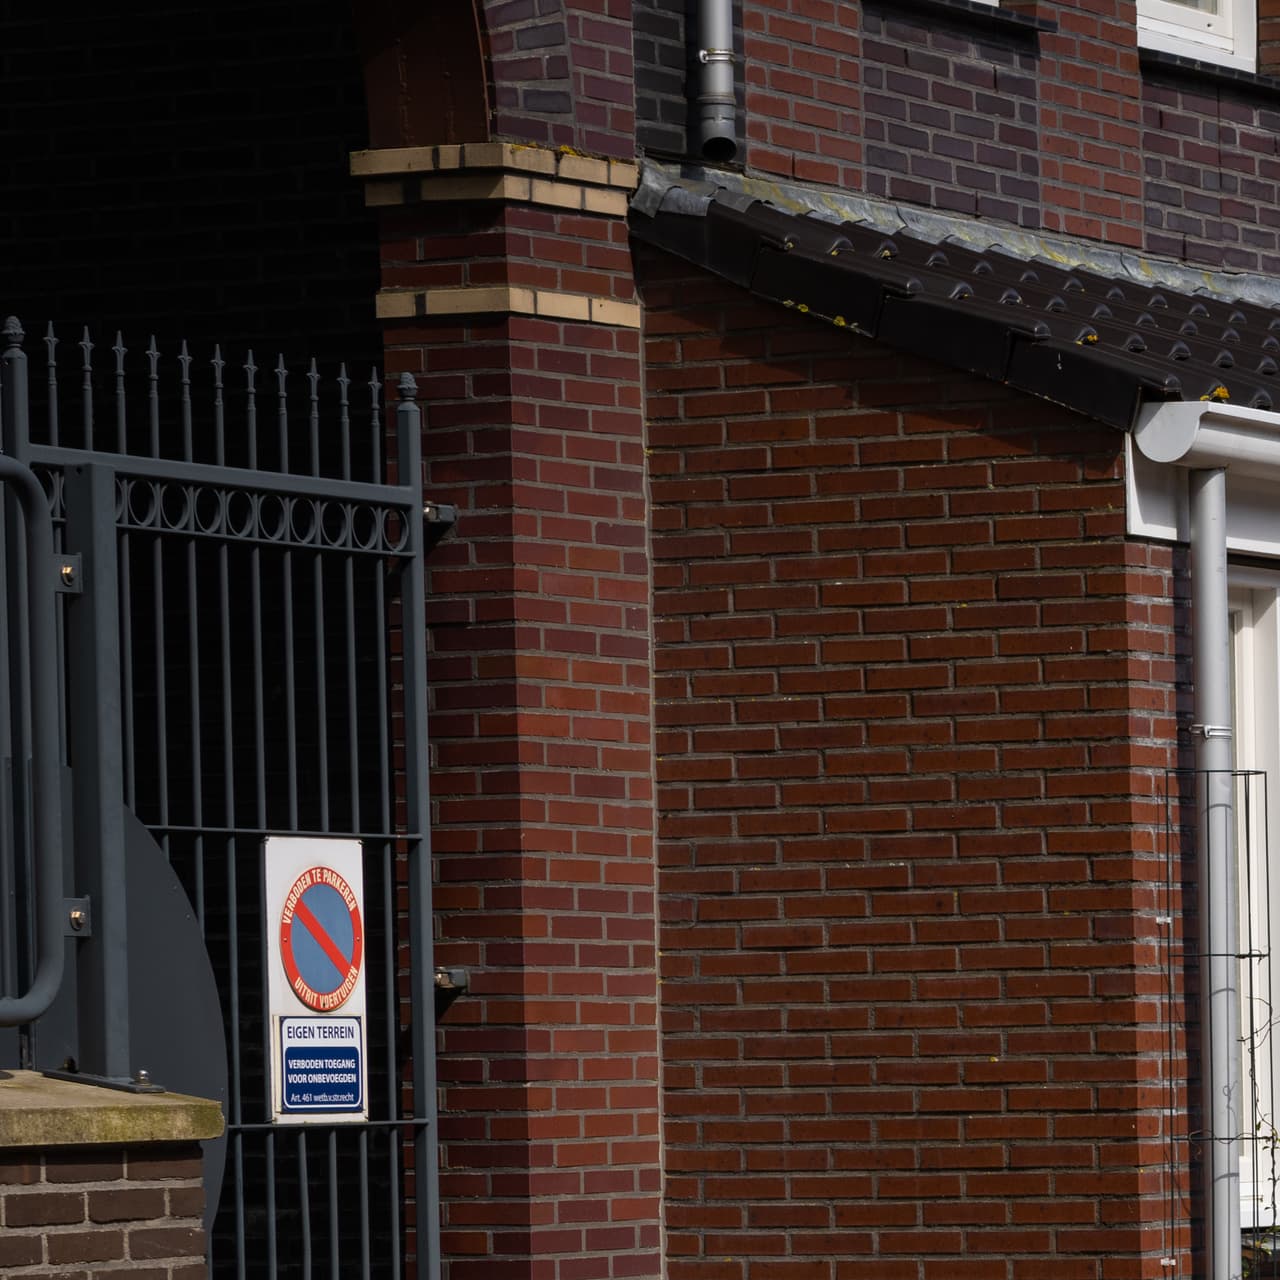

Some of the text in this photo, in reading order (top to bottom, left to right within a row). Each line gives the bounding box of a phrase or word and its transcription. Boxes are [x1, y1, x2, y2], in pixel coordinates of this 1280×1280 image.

[282, 868, 357, 925] VERBODEN TE PARKEREN
[294, 976, 318, 1007] UITRIT
[287, 1026, 355, 1039] EIGEN TERREIN
[288, 1059, 356, 1069] VERBODEN TOEGANG
[288, 1073, 357, 1084] VOOR ONBEVOEGDEN
